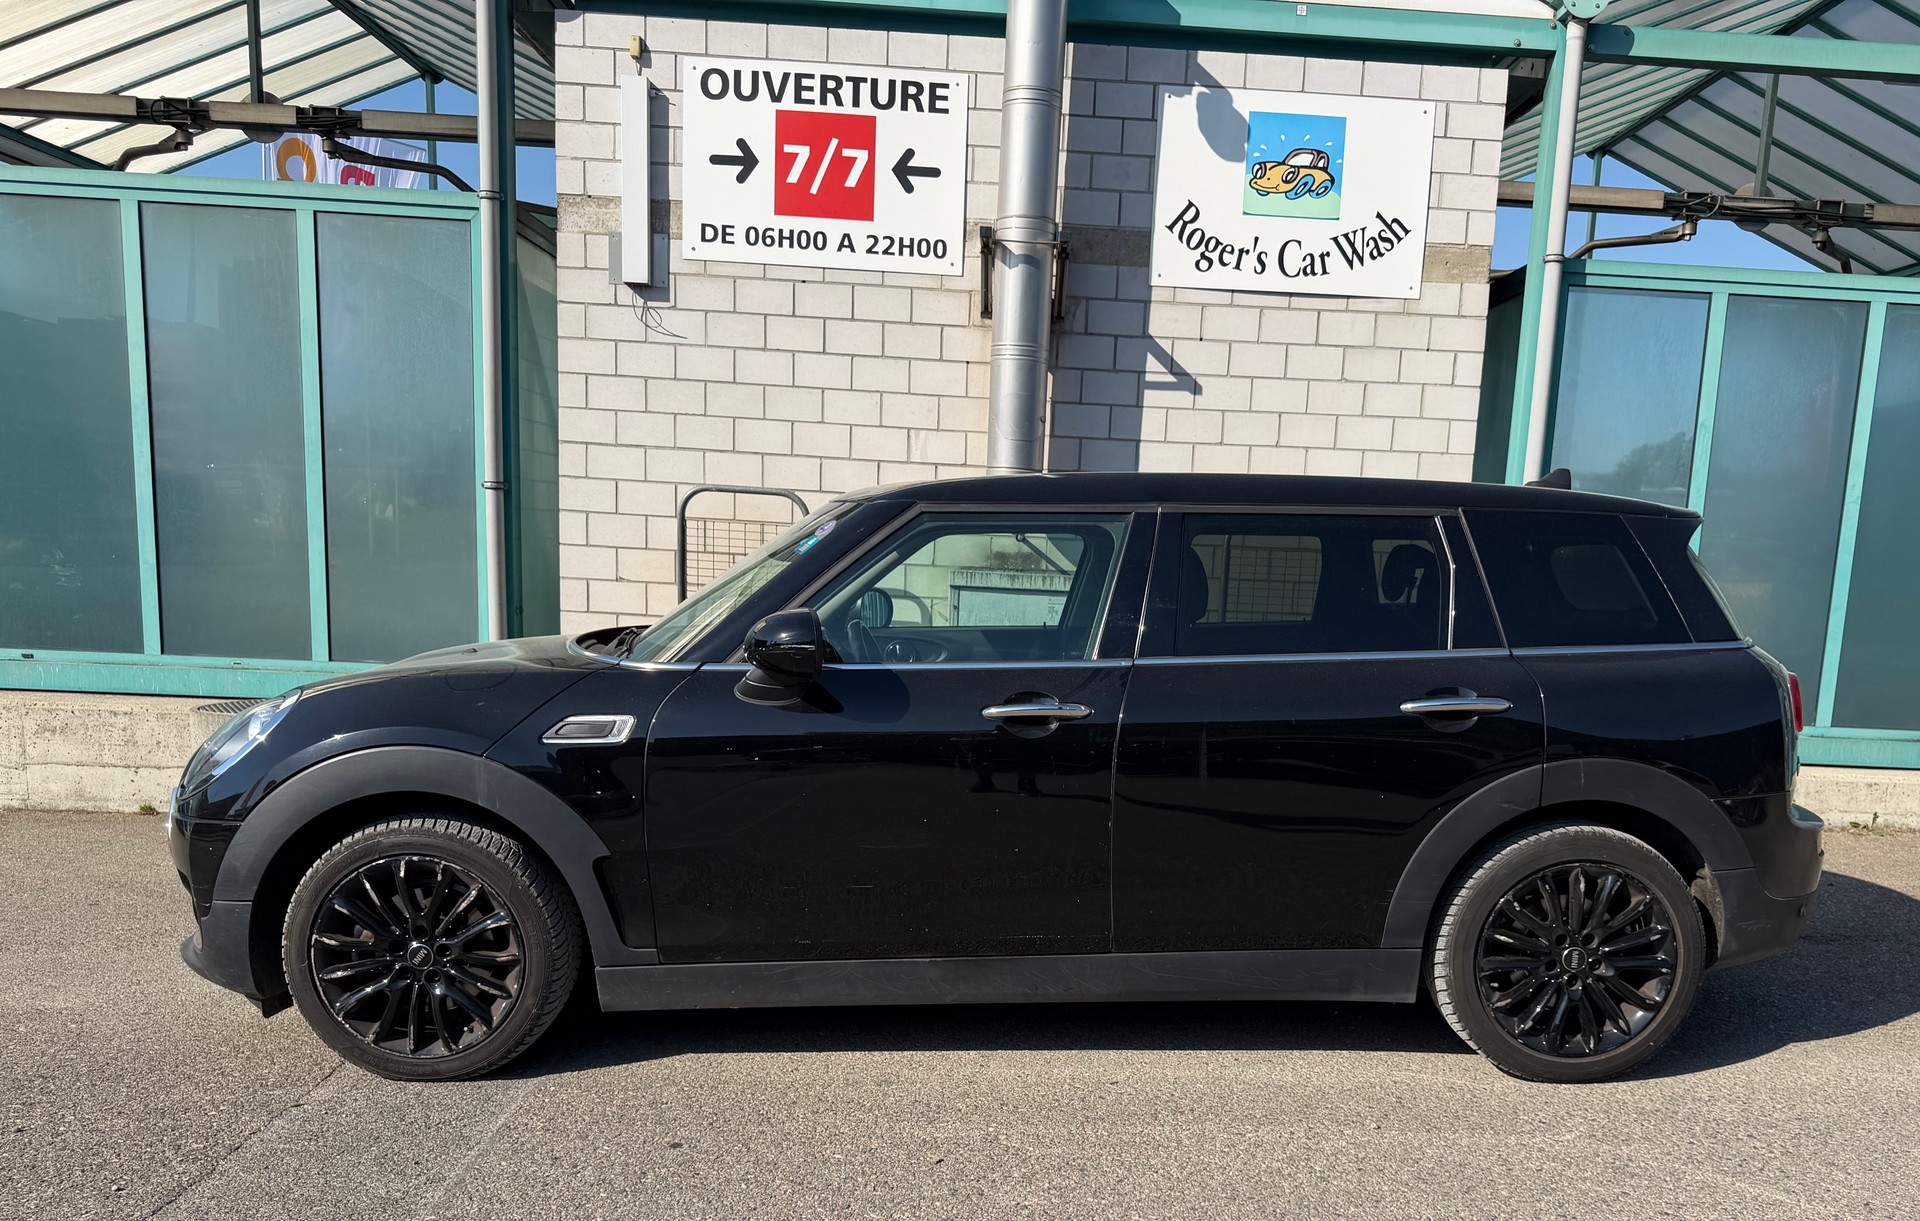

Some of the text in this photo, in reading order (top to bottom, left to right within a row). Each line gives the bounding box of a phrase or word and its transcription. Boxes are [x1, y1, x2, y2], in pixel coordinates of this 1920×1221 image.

[700, 67, 950, 114] OUVERTURE
[783, 137, 869, 195] 7/7
[700, 222, 948, 259] DE 06H00 A 22H00
[1165, 199, 1412, 278] Roger's Car Wash
[411, 948, 428, 966] MINI
[1570, 950, 1579, 968] MINI
